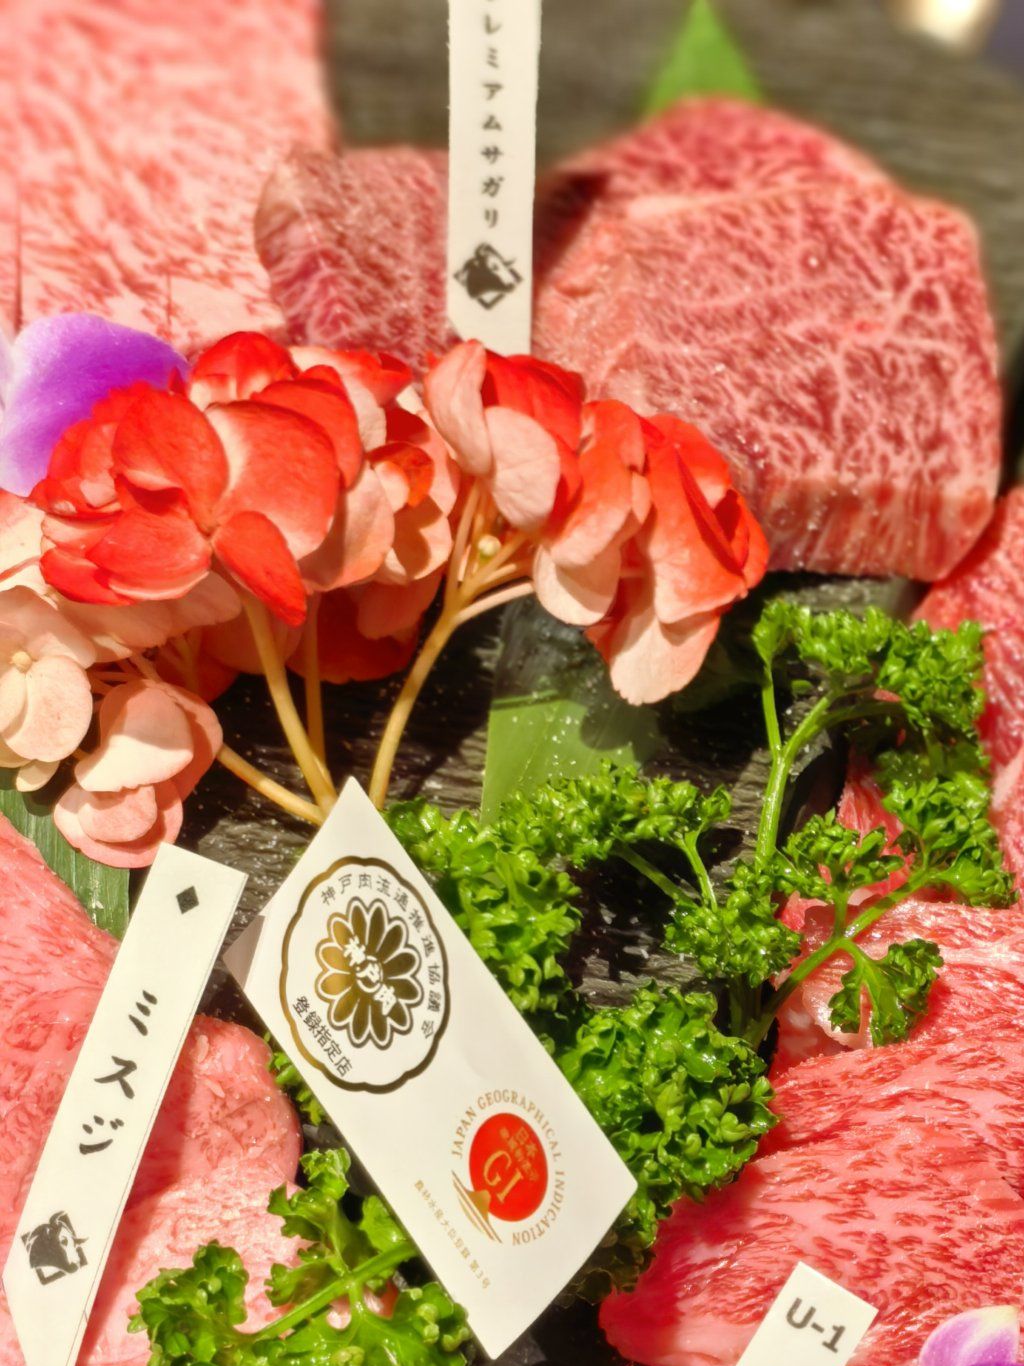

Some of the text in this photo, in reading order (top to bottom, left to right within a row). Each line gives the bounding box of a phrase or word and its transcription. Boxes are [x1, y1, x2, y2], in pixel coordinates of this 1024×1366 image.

[481, 0, 504, 228] レミアムサガリ
[79, 990, 158, 1156] ミスジ
[292, 996, 353, 1077] 登録指定店
[452, 1107, 477, 1159] JAPAN
[477, 1089, 562, 1162] GEOGRAPHICAL
[483, 1150, 524, 1204] GI
[512, 1170, 566, 1246] INDICATION
[786, 1297, 847, 1354] U-1
